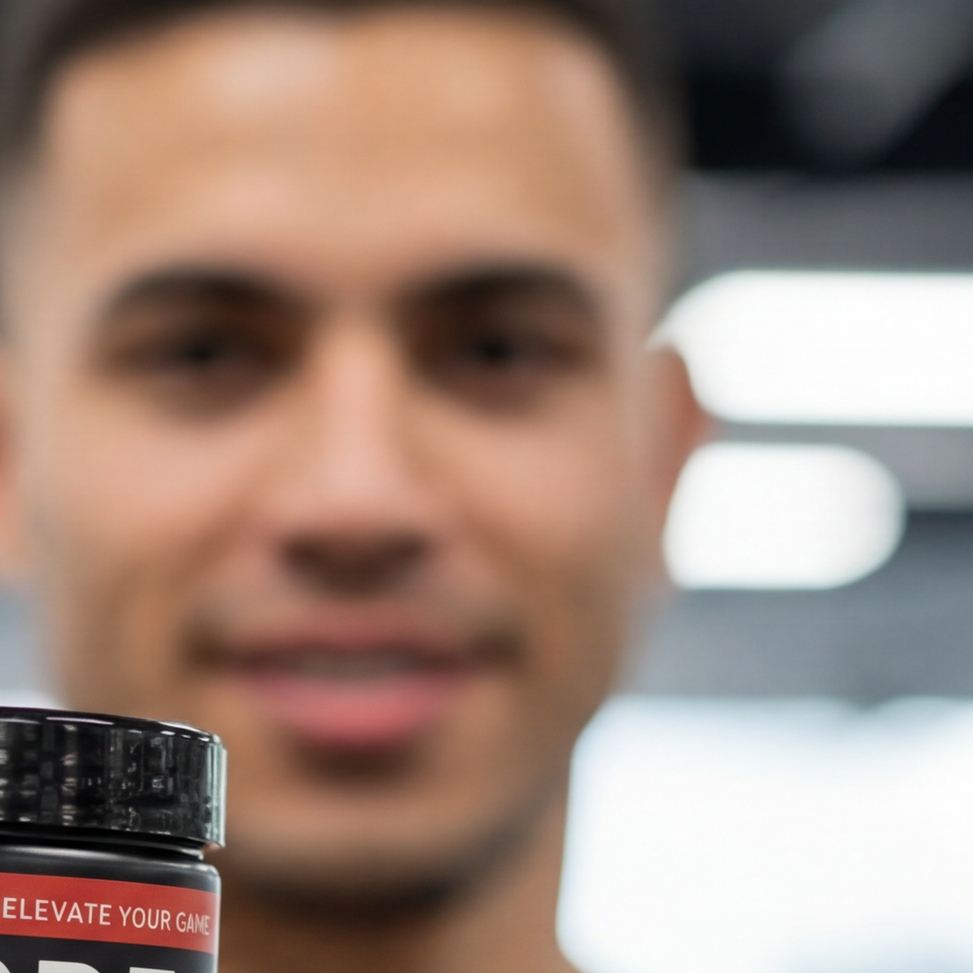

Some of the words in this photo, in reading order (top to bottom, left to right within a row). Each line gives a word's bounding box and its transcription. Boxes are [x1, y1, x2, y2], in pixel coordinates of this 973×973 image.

[2, 897, 112, 926] ELEVATE
[119, 905, 171, 931] YOUR
[176, 911, 211, 936] GAME
